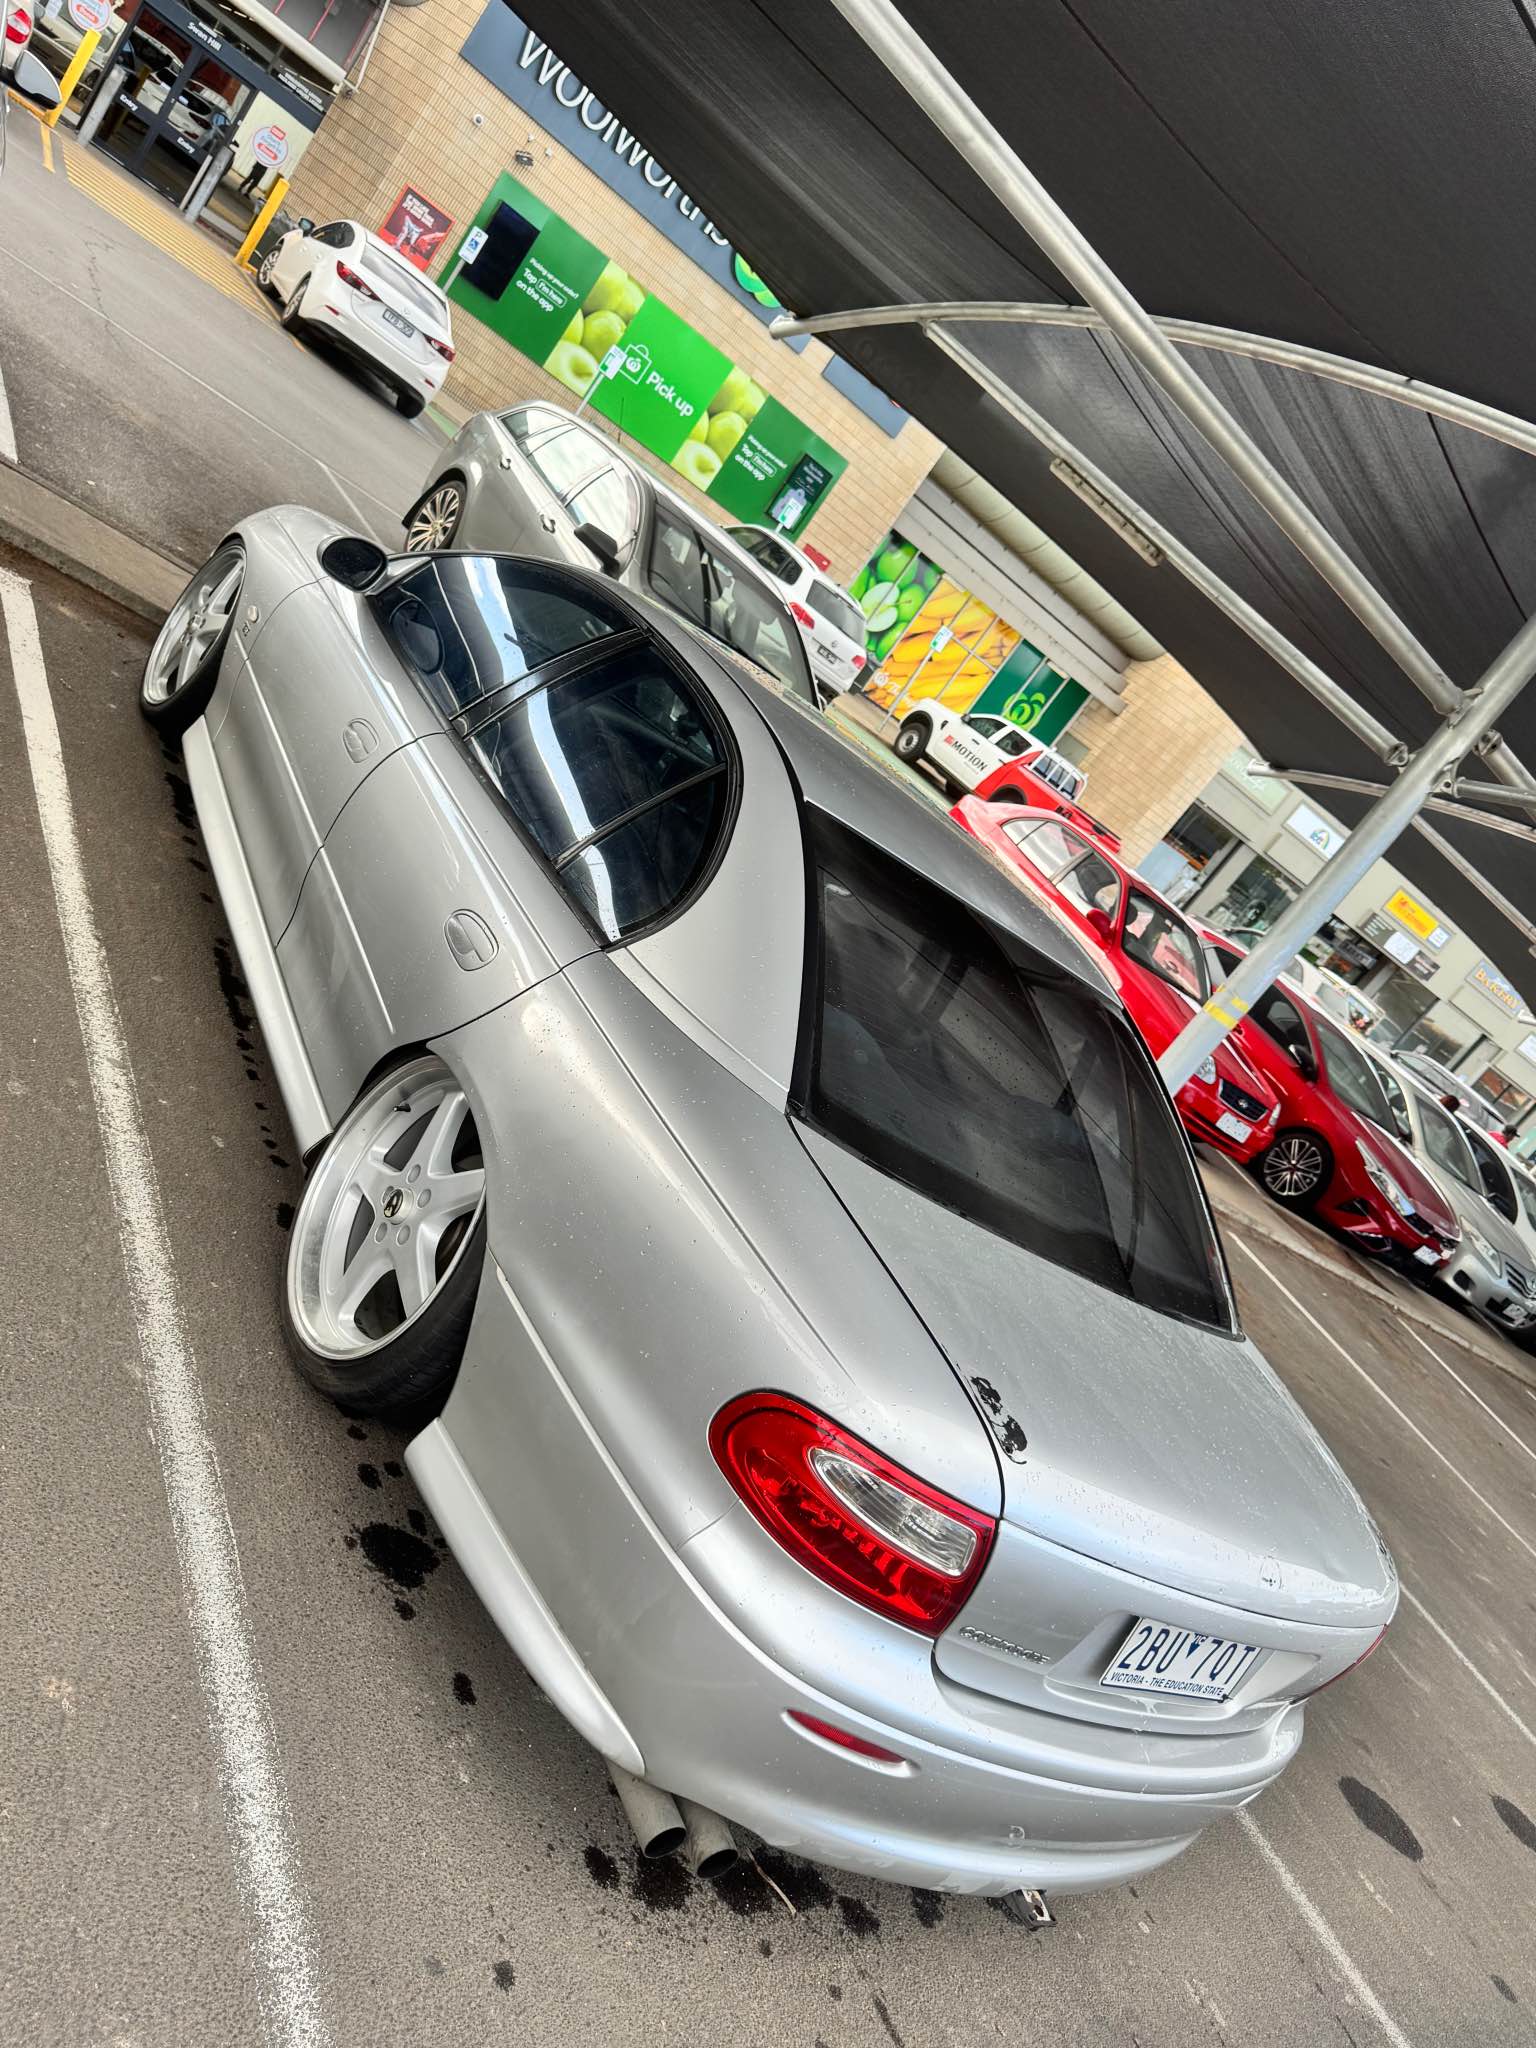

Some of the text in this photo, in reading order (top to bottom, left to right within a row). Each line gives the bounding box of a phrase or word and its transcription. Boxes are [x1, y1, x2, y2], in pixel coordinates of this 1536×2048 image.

[516, 30, 730, 247] Woolwo
[523, 267, 538, 284] Tap
[516, 280, 554, 312] on the app
[645, 371, 694, 417] Pick up
[951, 740, 988, 772] MOTION
[1117, 1625, 1191, 1674] 2BU
[1110, 1672, 1145, 1685] VICTORIA
[1150, 1677, 1165, 1687] THE
[1164, 1679, 1203, 1694] EDUCATION
[1202, 1685, 1225, 1696] STATE
